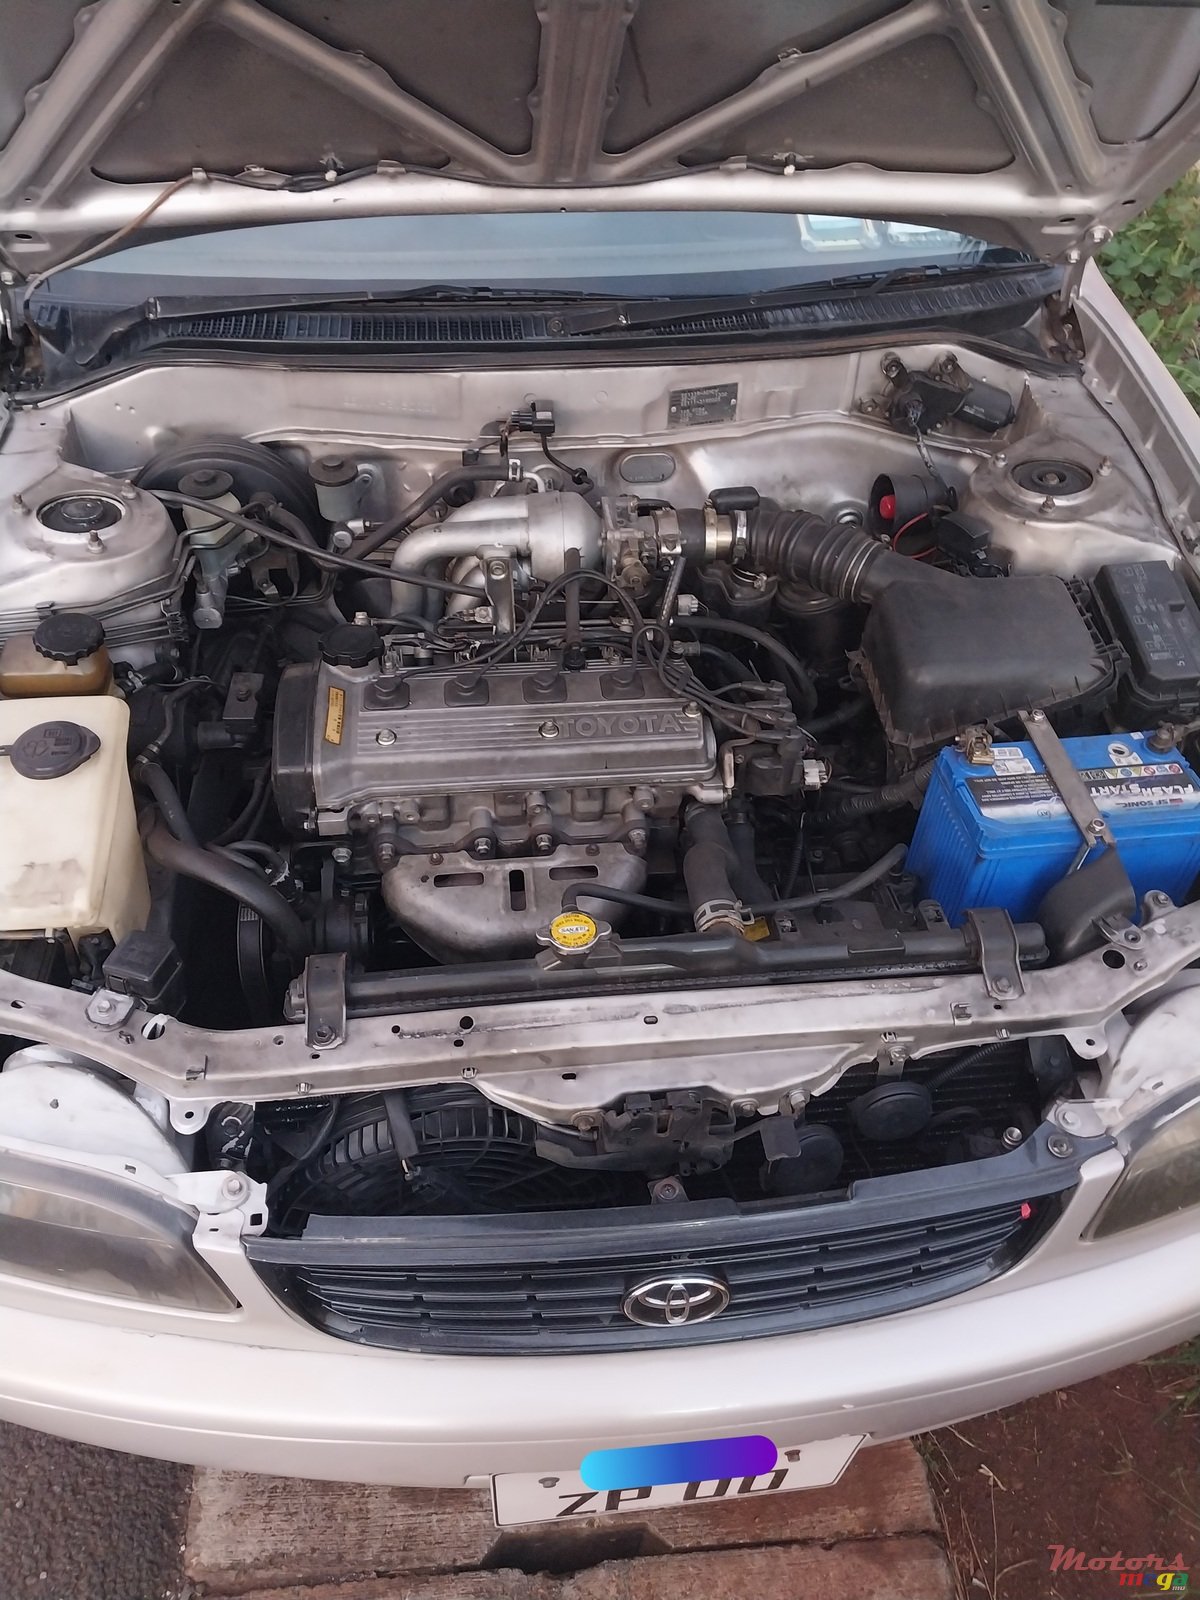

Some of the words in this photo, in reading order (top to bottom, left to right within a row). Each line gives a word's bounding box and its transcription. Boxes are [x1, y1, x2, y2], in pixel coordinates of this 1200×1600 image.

[557, 713, 682, 738] TOYOTA
[1090, 783, 1141, 797] START
[1141, 783, 1194, 797] FLASH
[556, 1485, 653, 1517] ZP
